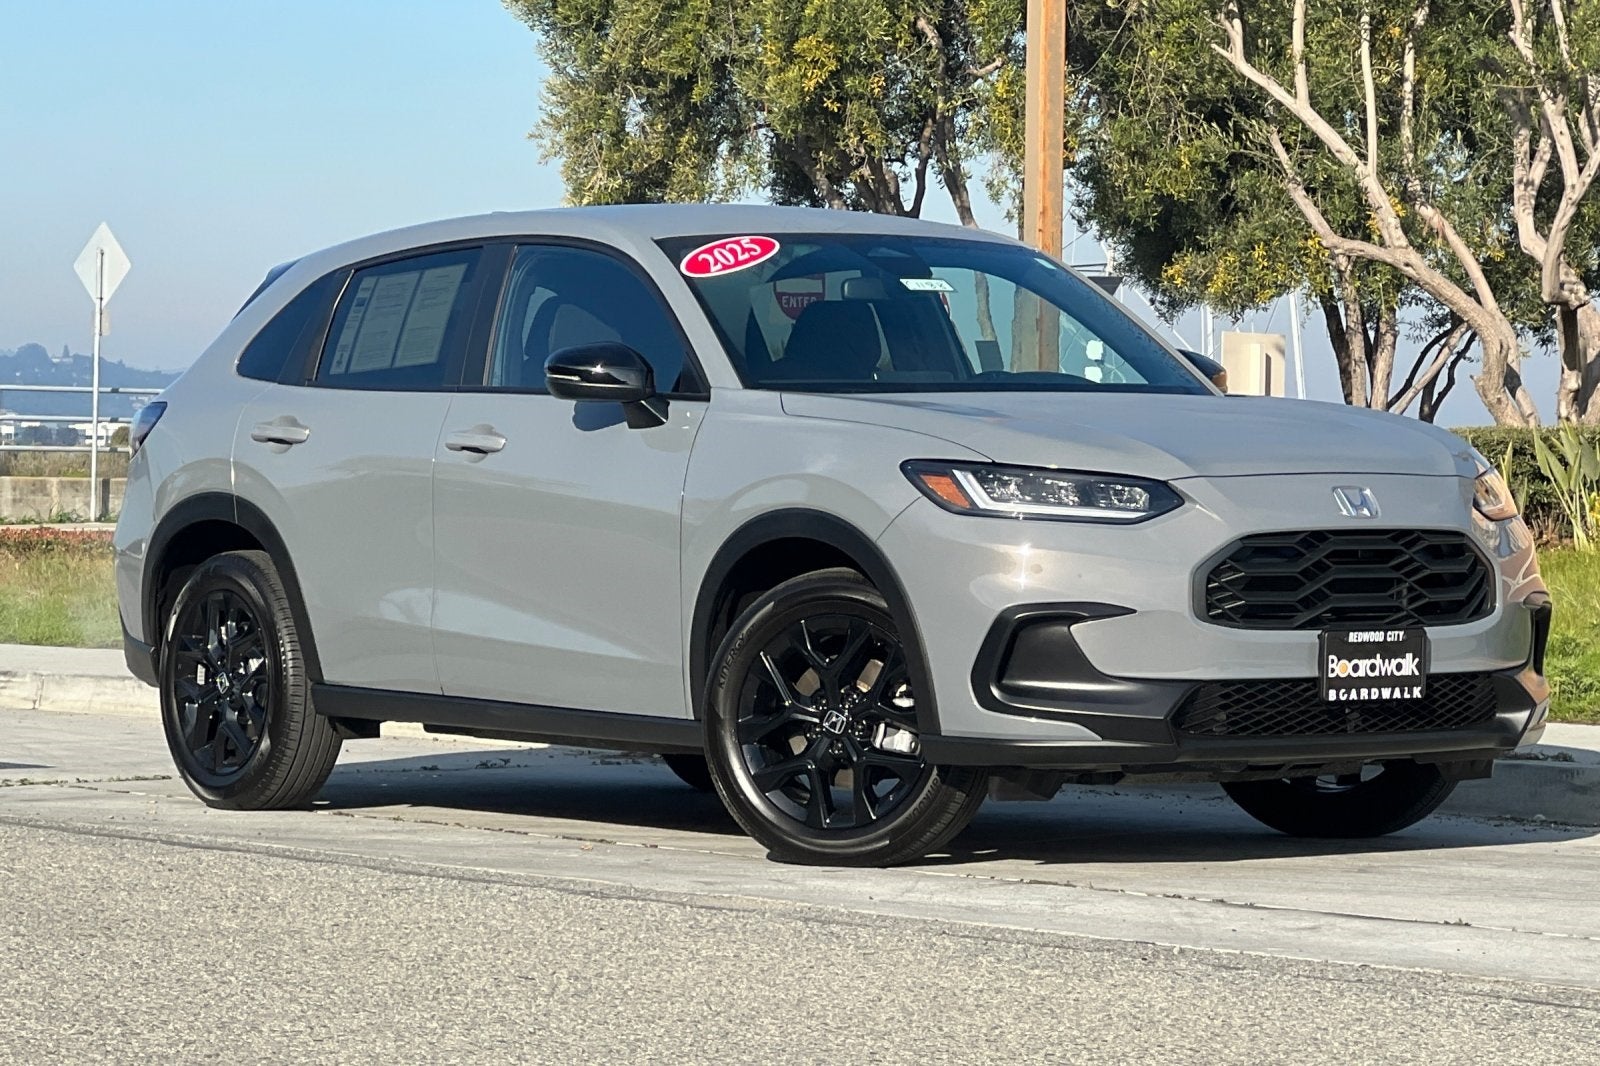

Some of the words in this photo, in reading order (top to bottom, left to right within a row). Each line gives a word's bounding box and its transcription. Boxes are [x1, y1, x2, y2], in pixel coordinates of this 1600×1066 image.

[698, 238, 761, 273] 2025
[1348, 631, 1385, 643] REDWOOD
[1386, 630, 1405, 642] CITY
[1328, 652, 1420, 678] Boardwalk
[1328, 686, 1422, 701] BOARDWALK
